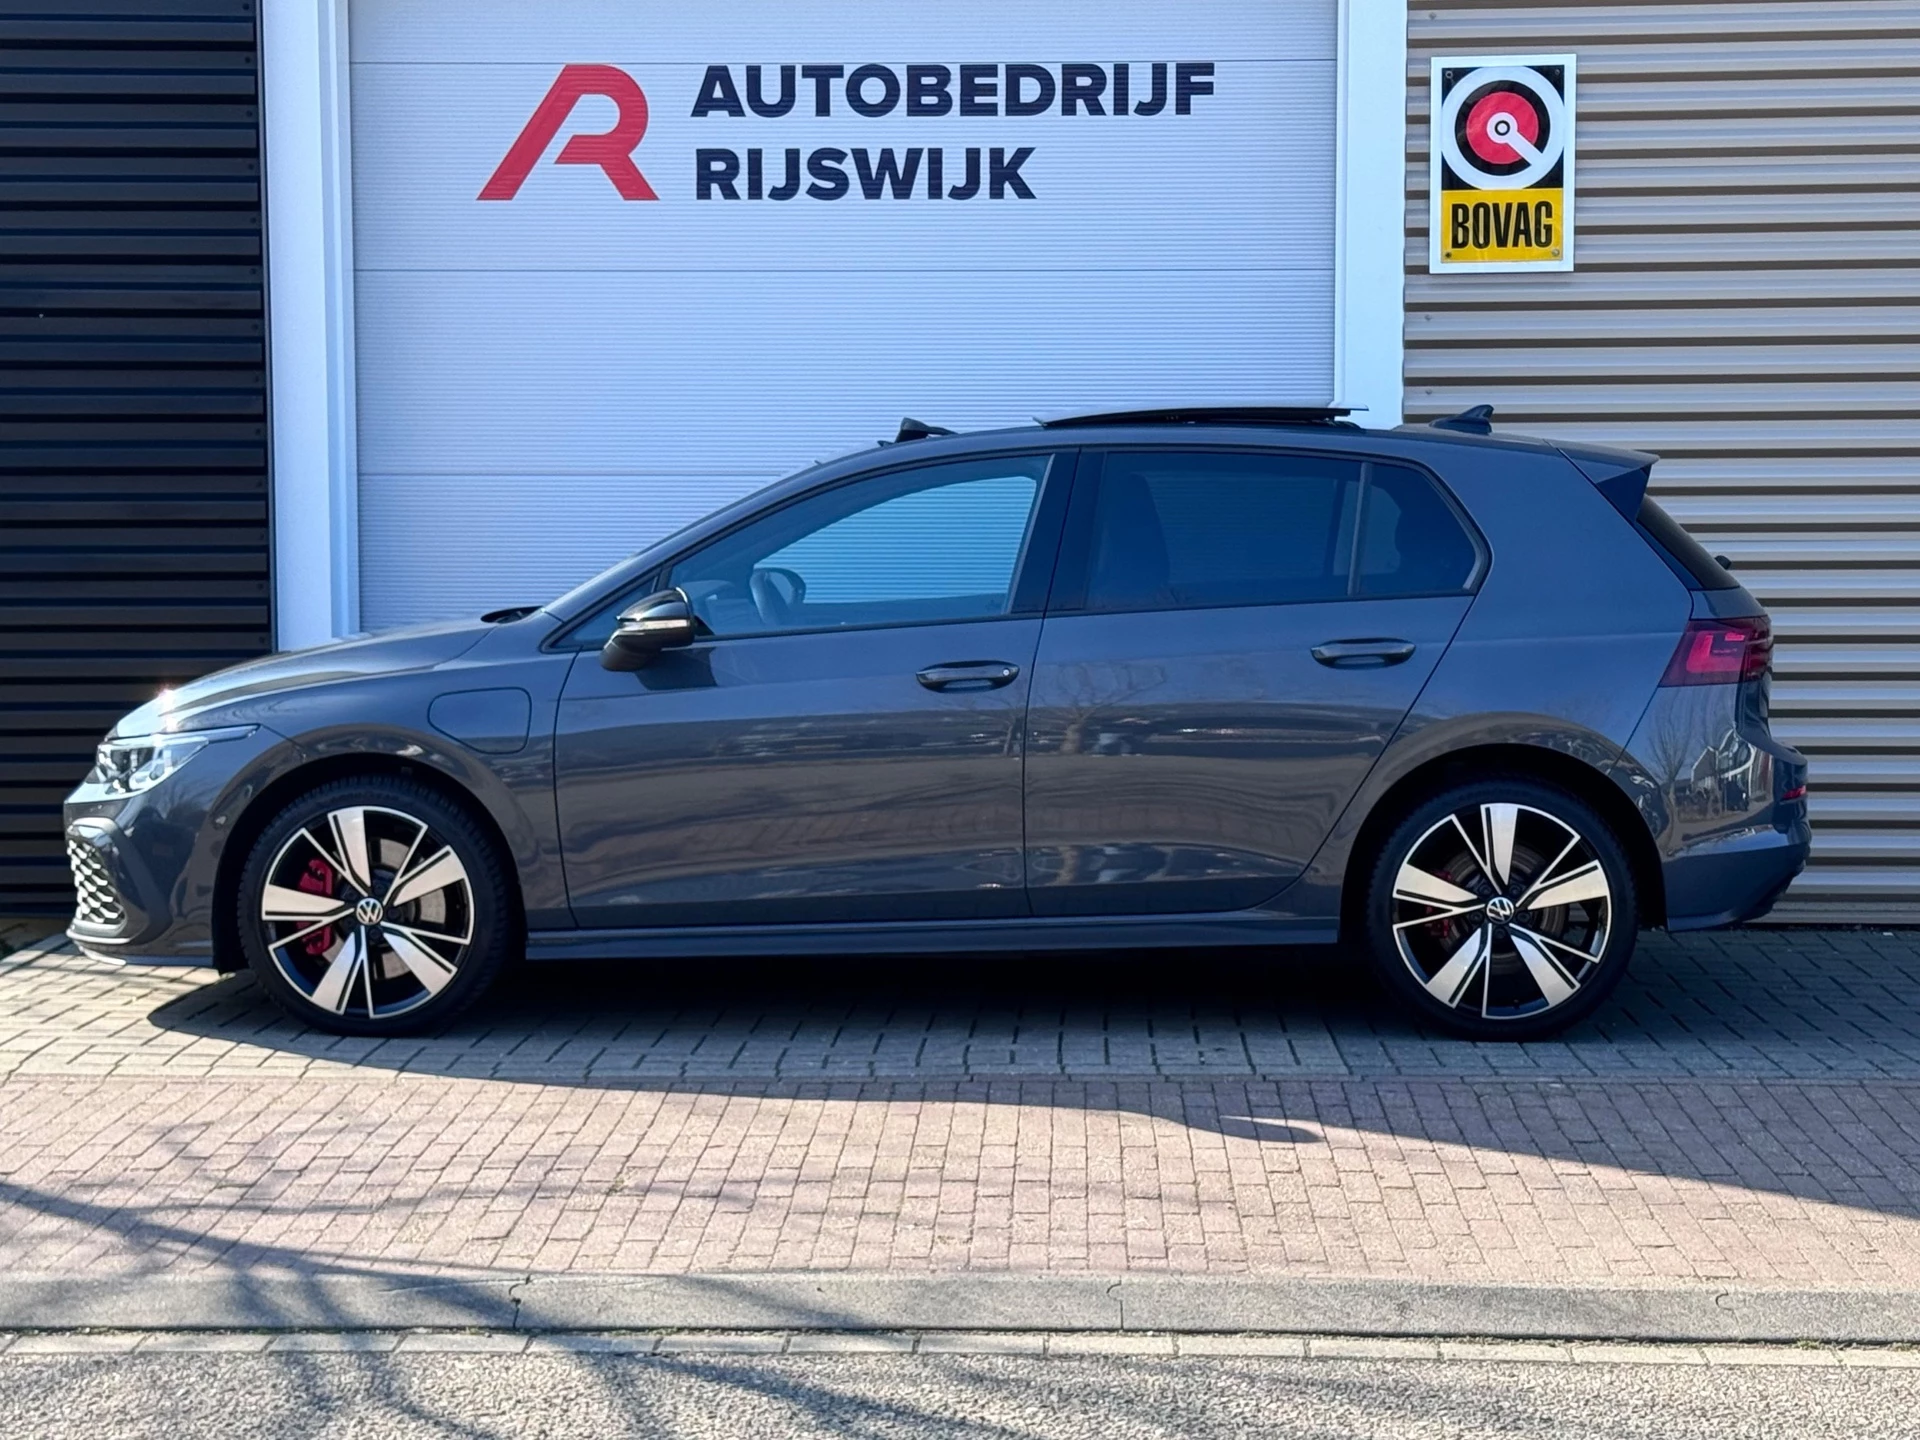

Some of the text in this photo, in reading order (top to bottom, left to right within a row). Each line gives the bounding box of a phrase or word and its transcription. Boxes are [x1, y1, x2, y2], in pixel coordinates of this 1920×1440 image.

[690, 62, 1216, 118] AUTOBEDRIJF
[696, 147, 1037, 201] RIJSWIJK
[1451, 200, 1553, 249] BOVAG
